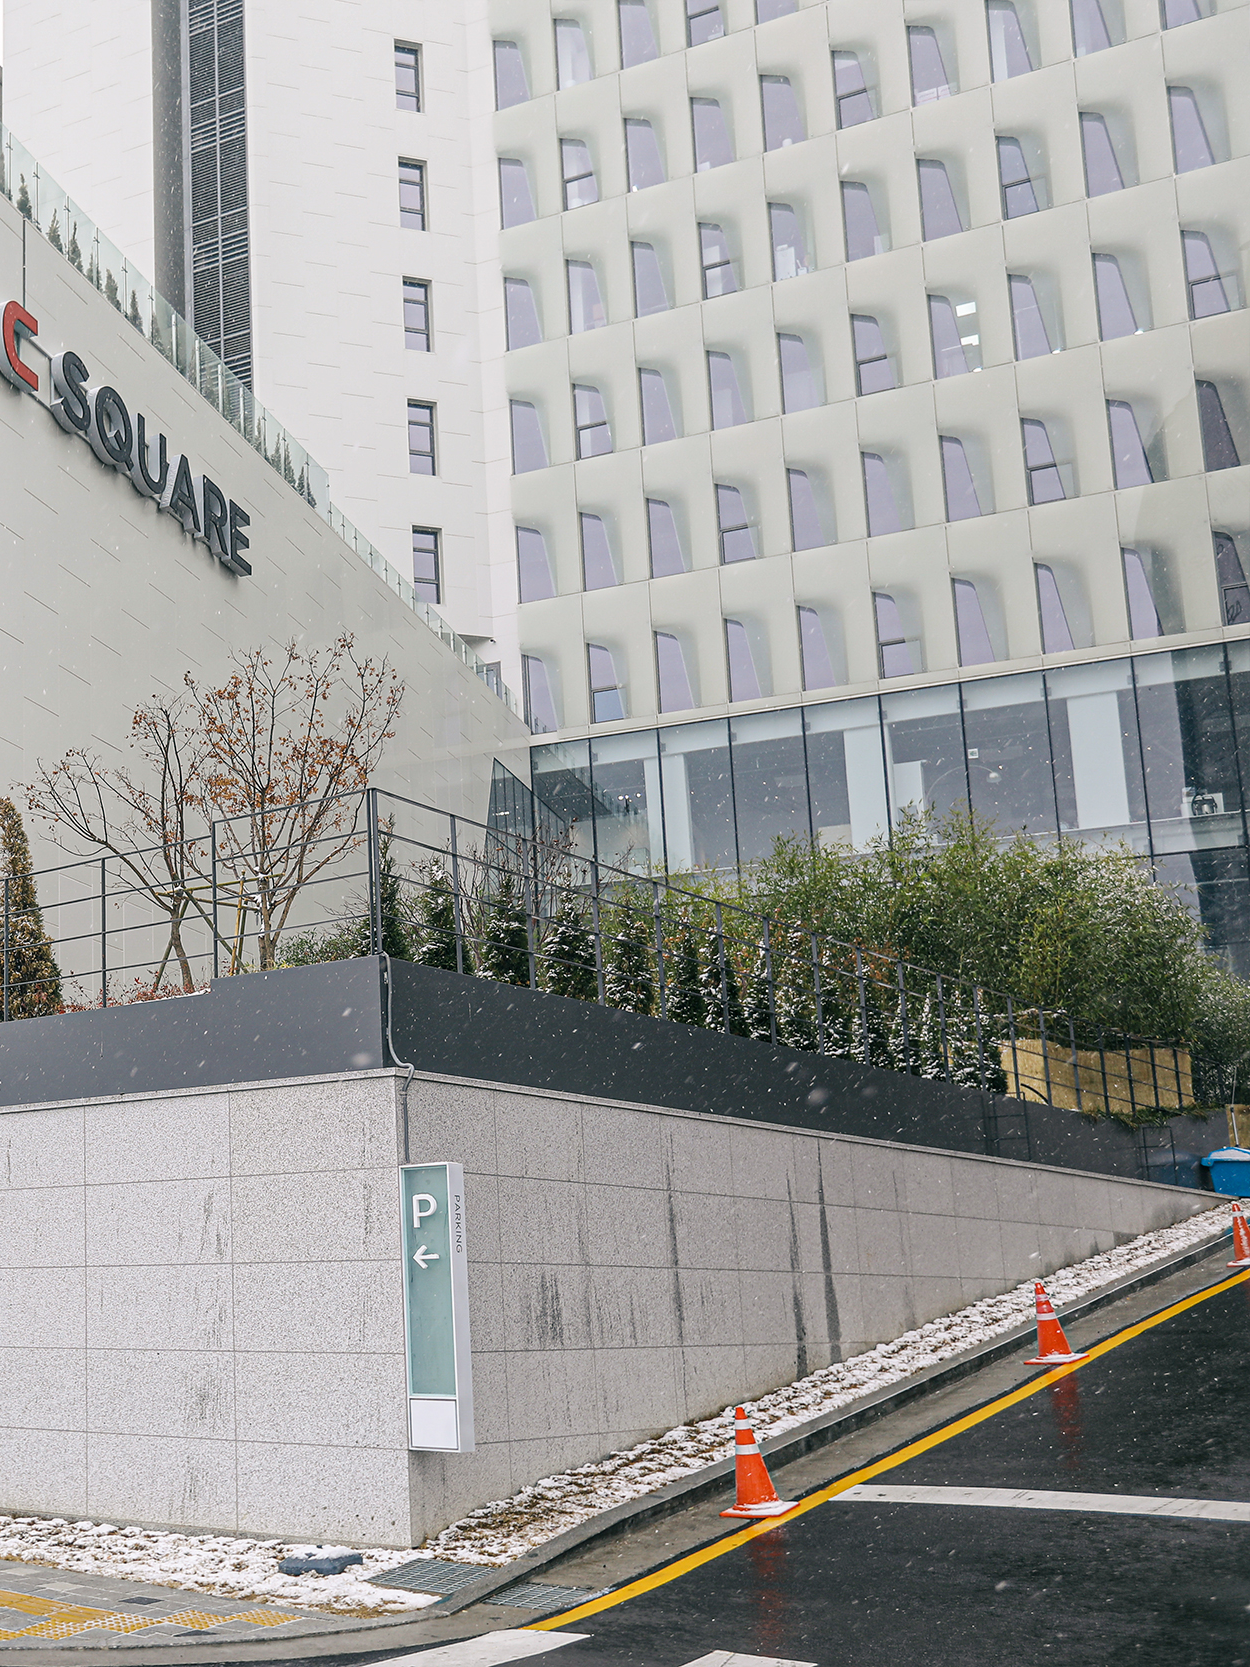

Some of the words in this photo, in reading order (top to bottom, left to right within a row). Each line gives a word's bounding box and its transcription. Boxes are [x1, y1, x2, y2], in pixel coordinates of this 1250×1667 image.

[50, 350, 252, 577] SQUARE
[412, 1193, 438, 1228] P
[454, 1194, 463, 1254] PARKING
